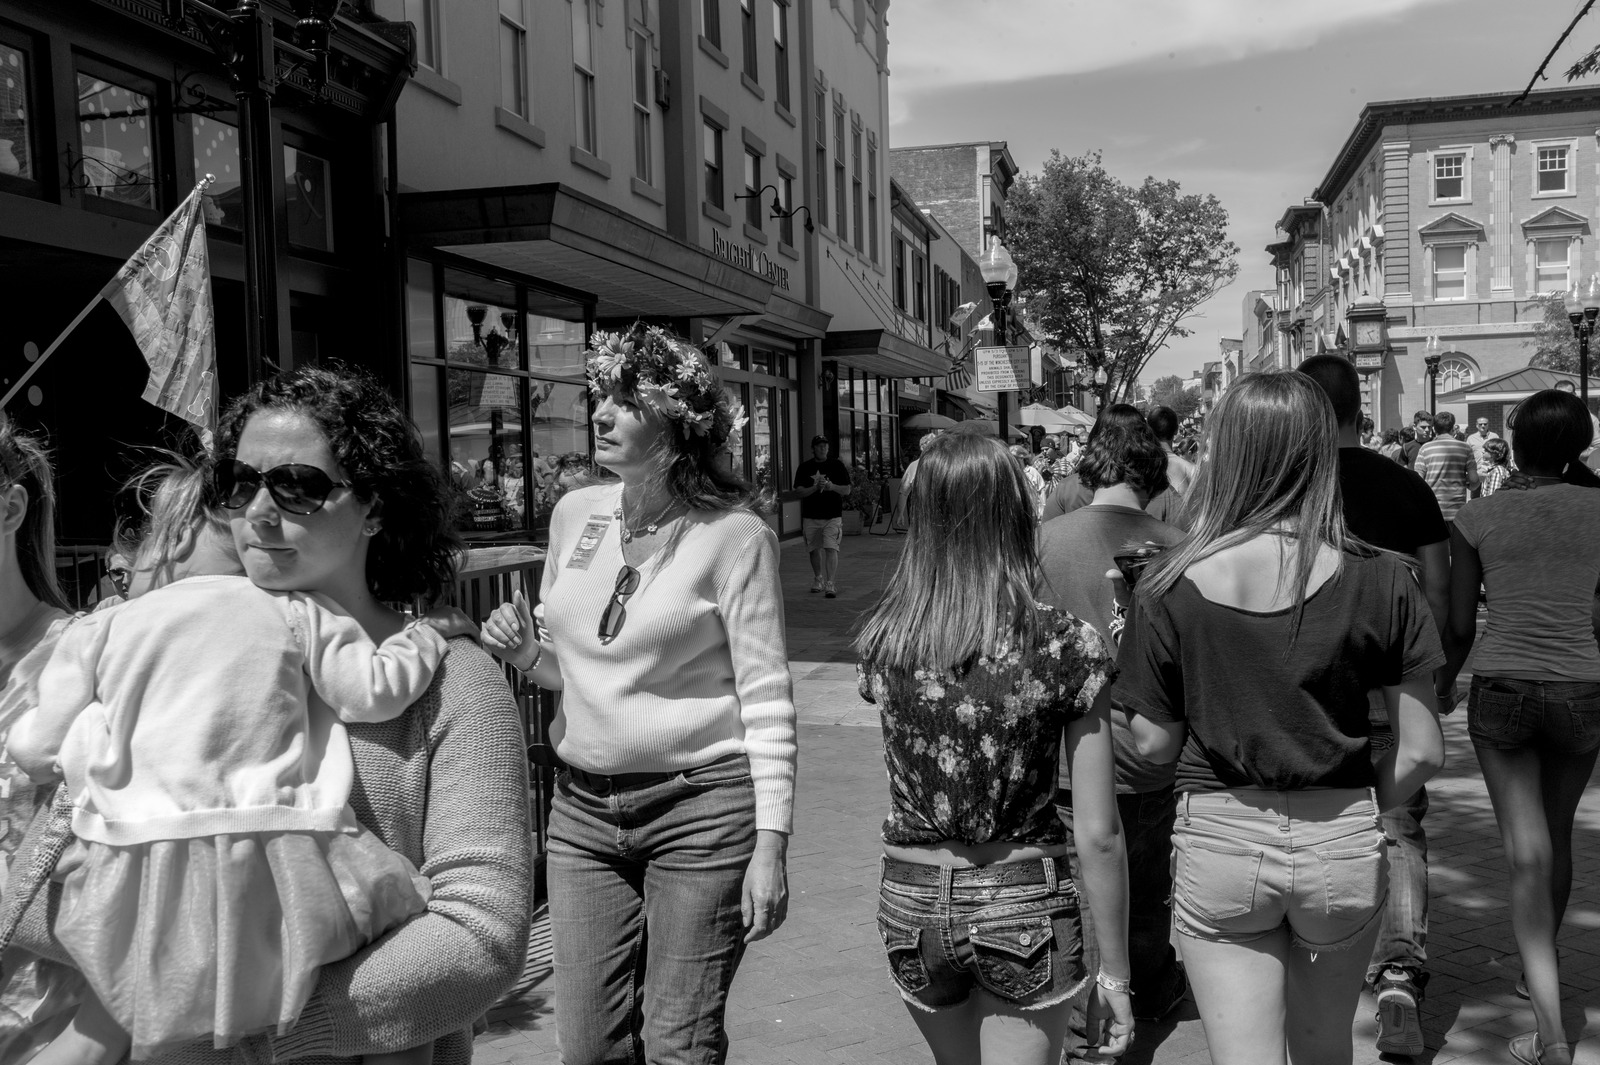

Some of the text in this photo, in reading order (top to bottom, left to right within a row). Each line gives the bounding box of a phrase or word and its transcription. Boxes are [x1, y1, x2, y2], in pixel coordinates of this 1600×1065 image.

[712, 227, 790, 291] BRIGHT CENTER
[1405, 327, 1464, 335] FARMERS
